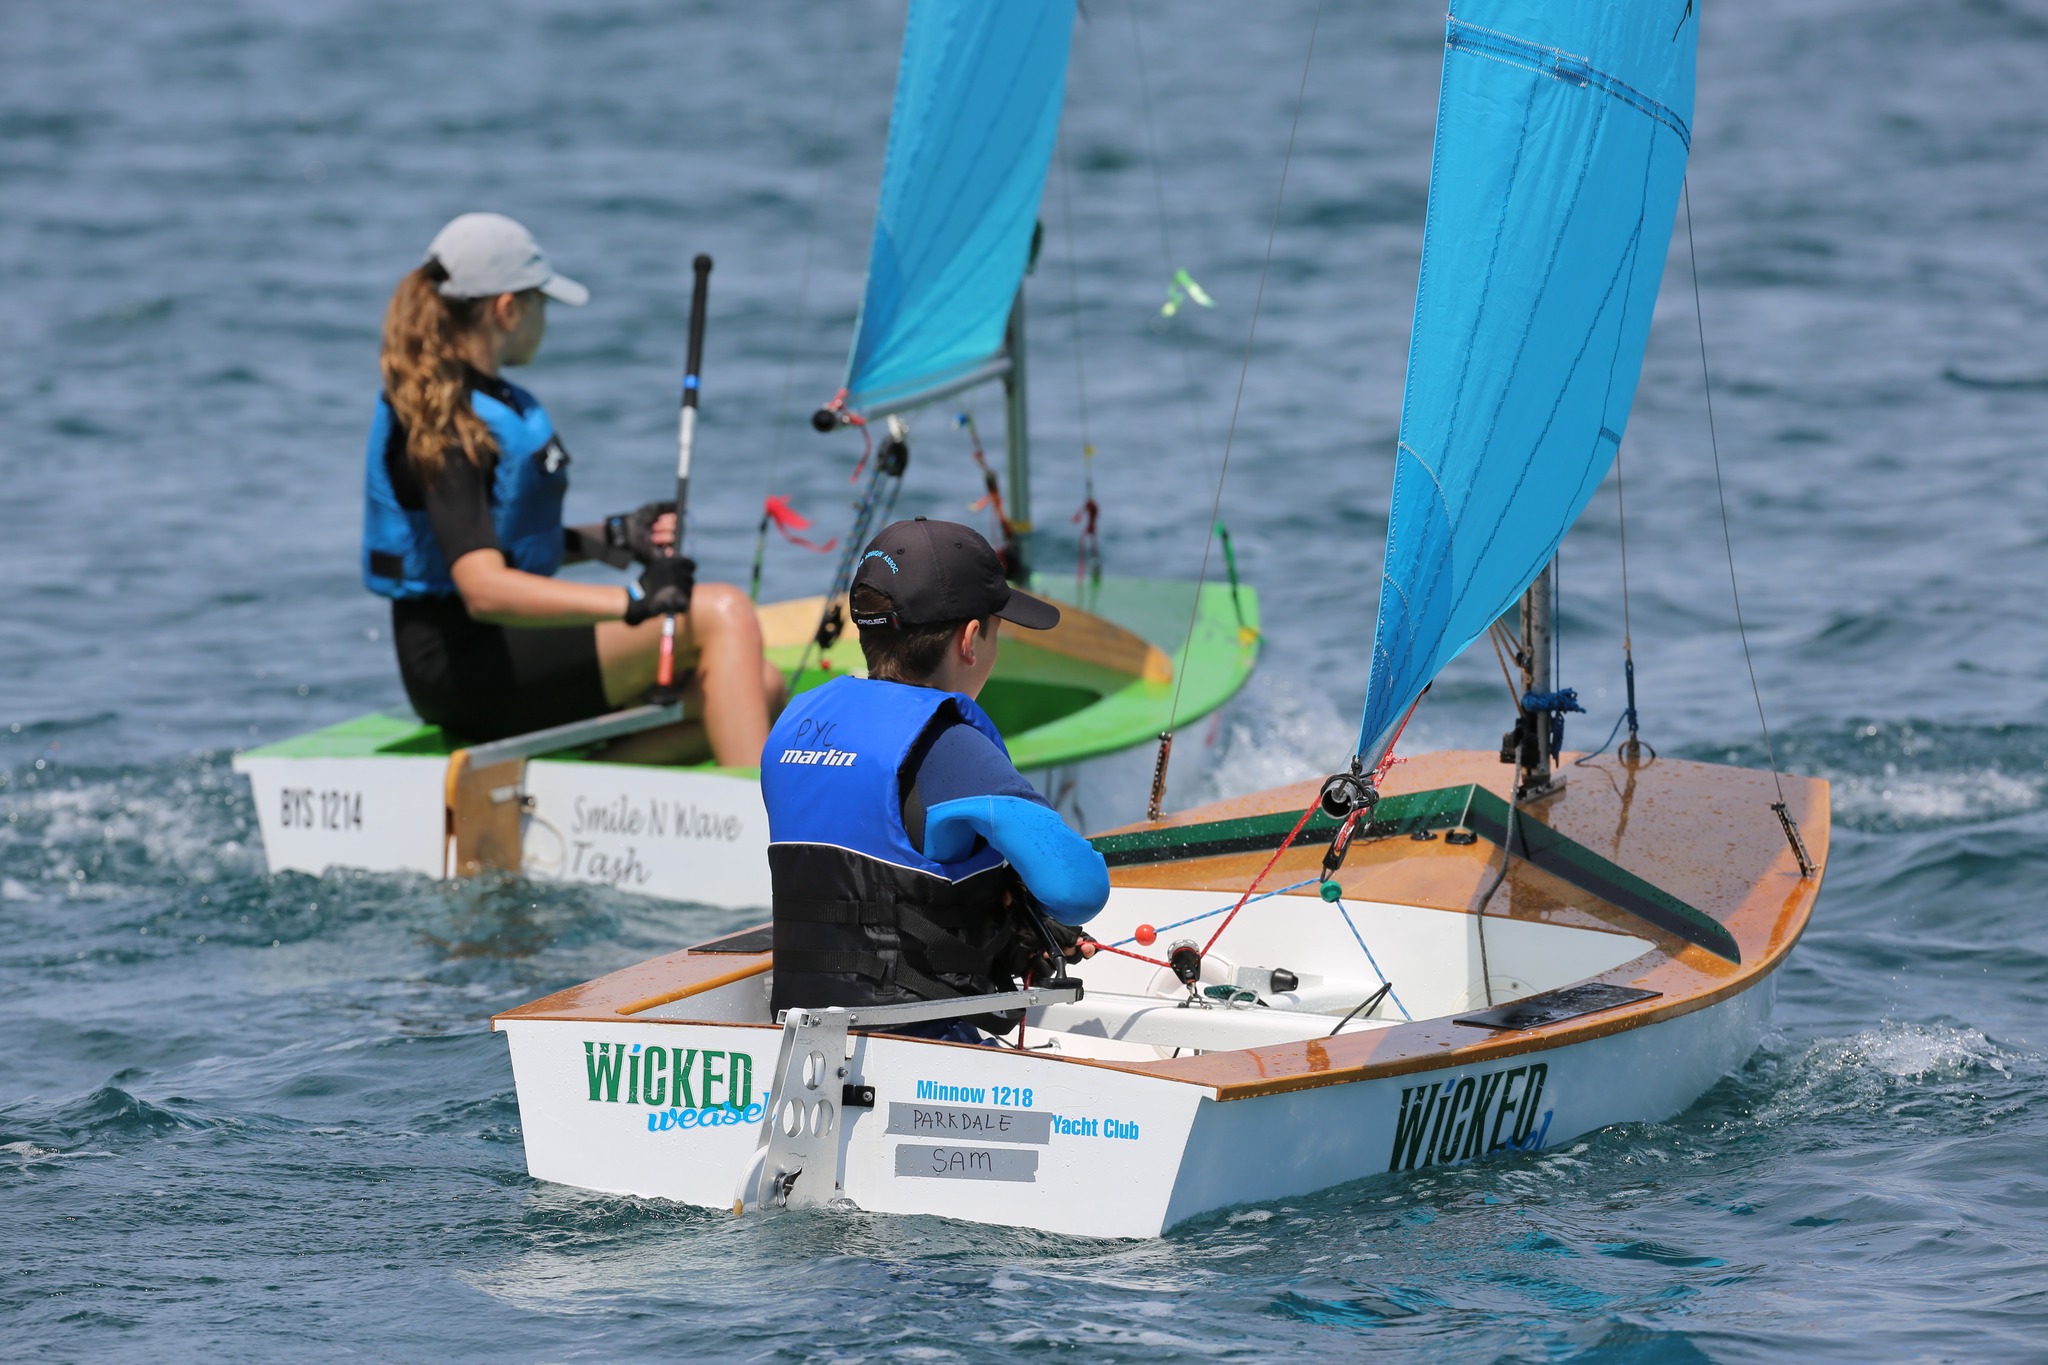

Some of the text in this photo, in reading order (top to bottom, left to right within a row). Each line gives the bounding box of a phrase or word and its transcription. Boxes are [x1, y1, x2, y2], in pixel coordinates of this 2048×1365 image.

[793, 718, 837, 747] PYC
[779, 748, 857, 767] marlin
[281, 787, 362, 830] BYS 1214
[571, 793, 744, 842] Smile N Wave
[571, 840, 652, 885] Tash
[916, 1079, 1034, 1108] Minnow 1218
[913, 1109, 1013, 1131] PARKDALE
[1052, 1114, 1140, 1140] Yacht Club
[932, 1148, 993, 1173] SAM
